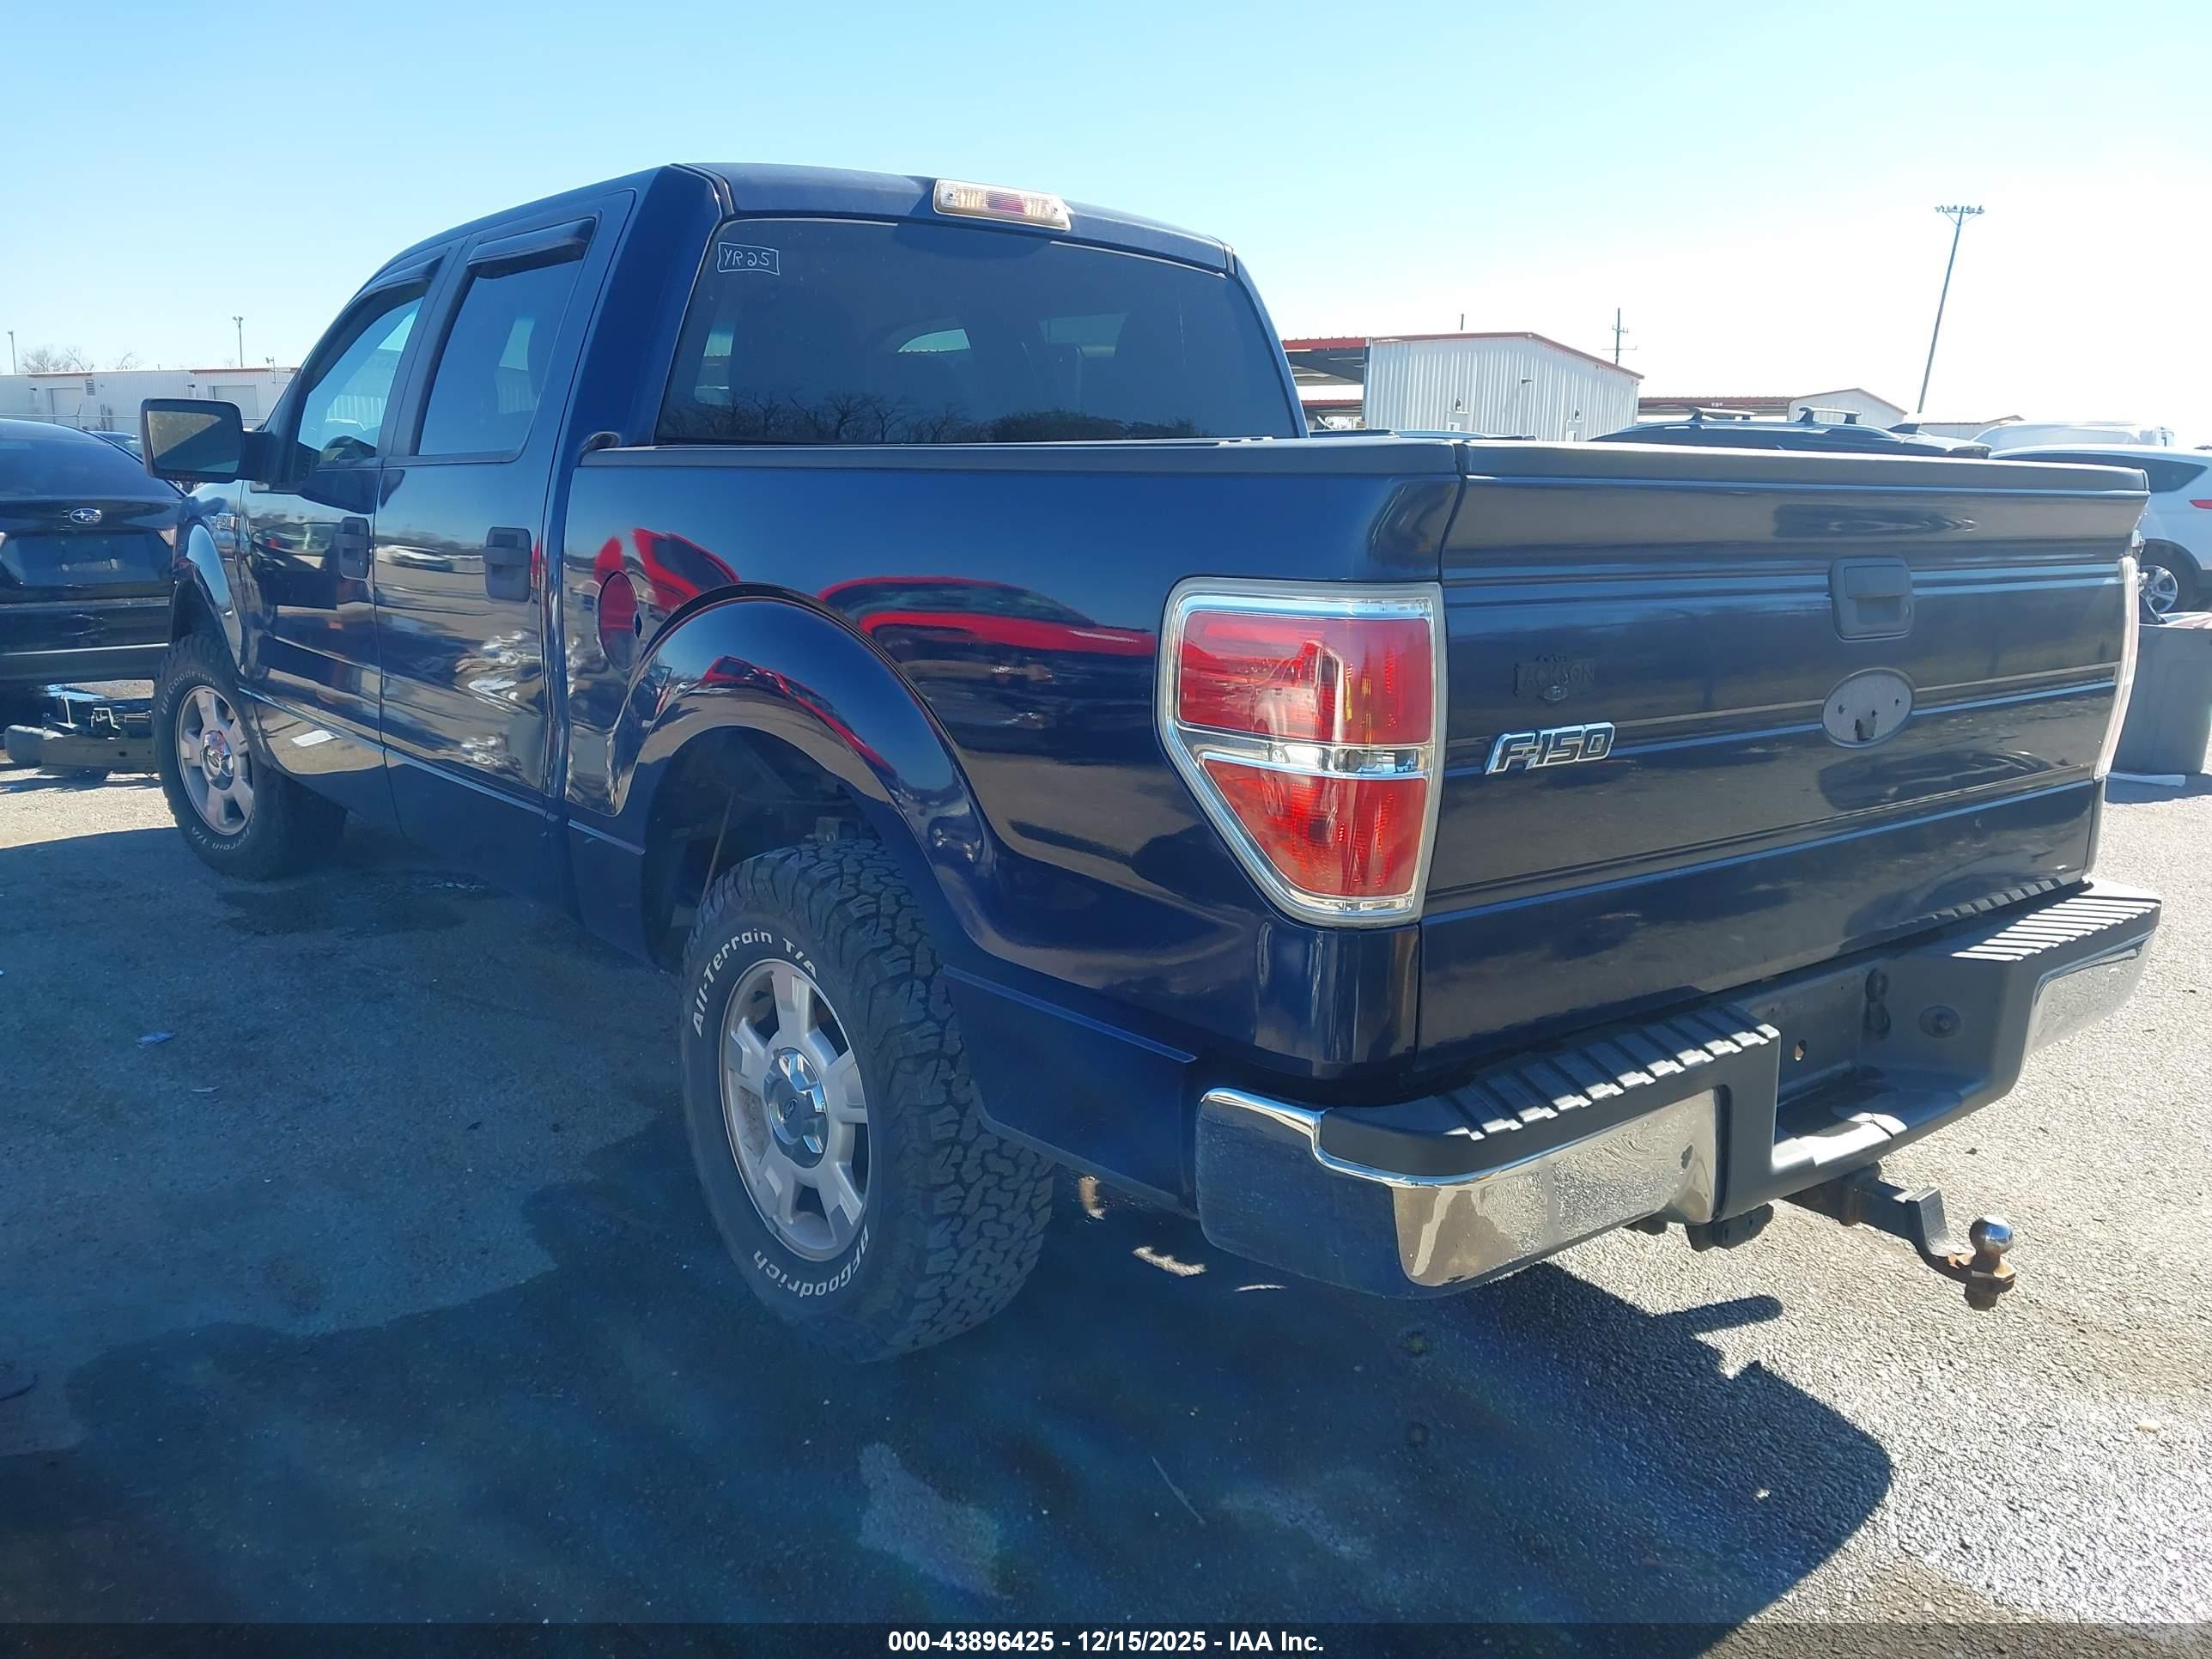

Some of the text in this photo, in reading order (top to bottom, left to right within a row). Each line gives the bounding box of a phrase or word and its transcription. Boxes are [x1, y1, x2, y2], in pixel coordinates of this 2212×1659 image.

[1485, 721, 1615, 775] F-150
[693, 927, 817, 1038] All-Terrain T/A
[753, 1223, 870, 1298] BFGoodrich
